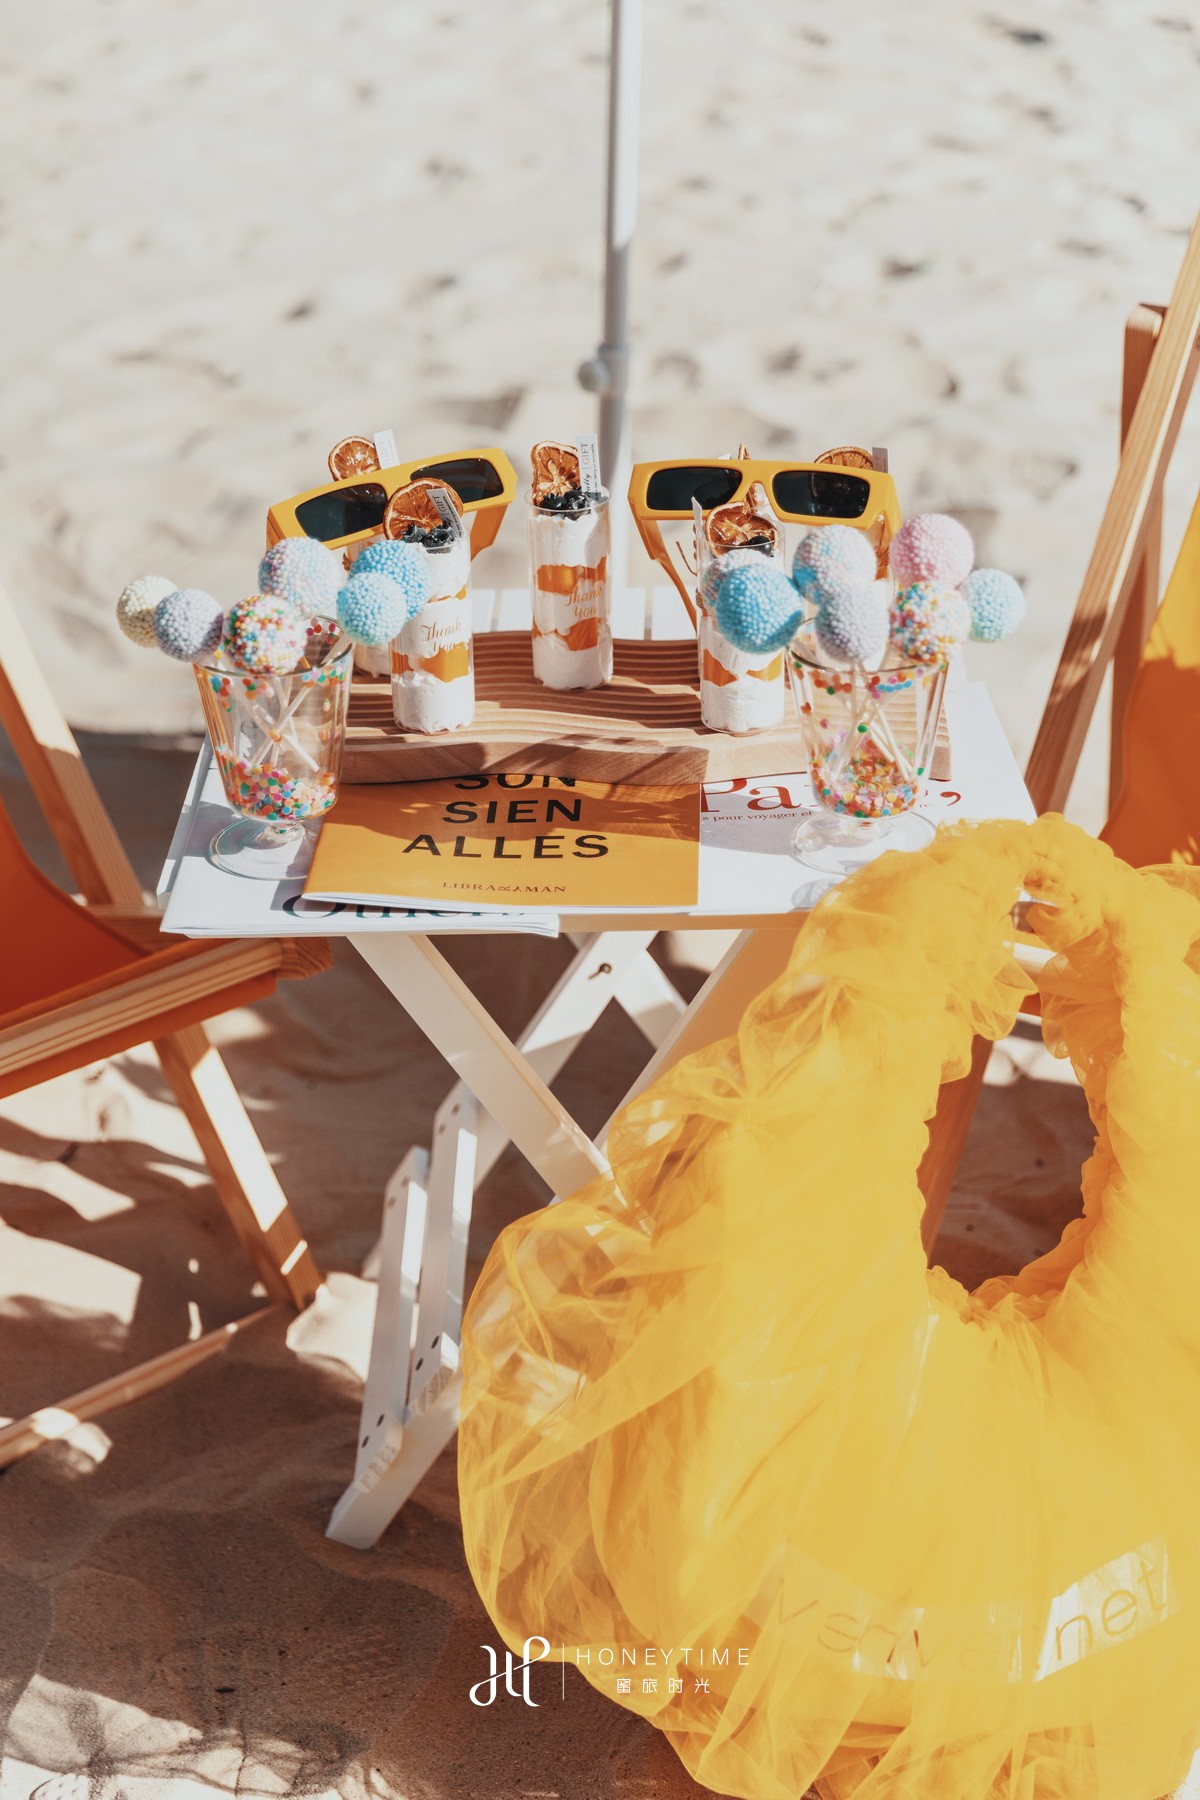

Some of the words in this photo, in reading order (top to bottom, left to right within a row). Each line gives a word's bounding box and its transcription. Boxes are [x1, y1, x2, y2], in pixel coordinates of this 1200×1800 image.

[420, 615, 461, 641] Thank
[441, 798, 582, 824] SIEN
[747, 811, 798, 821] voyager
[402, 833, 609, 859] ALLES
